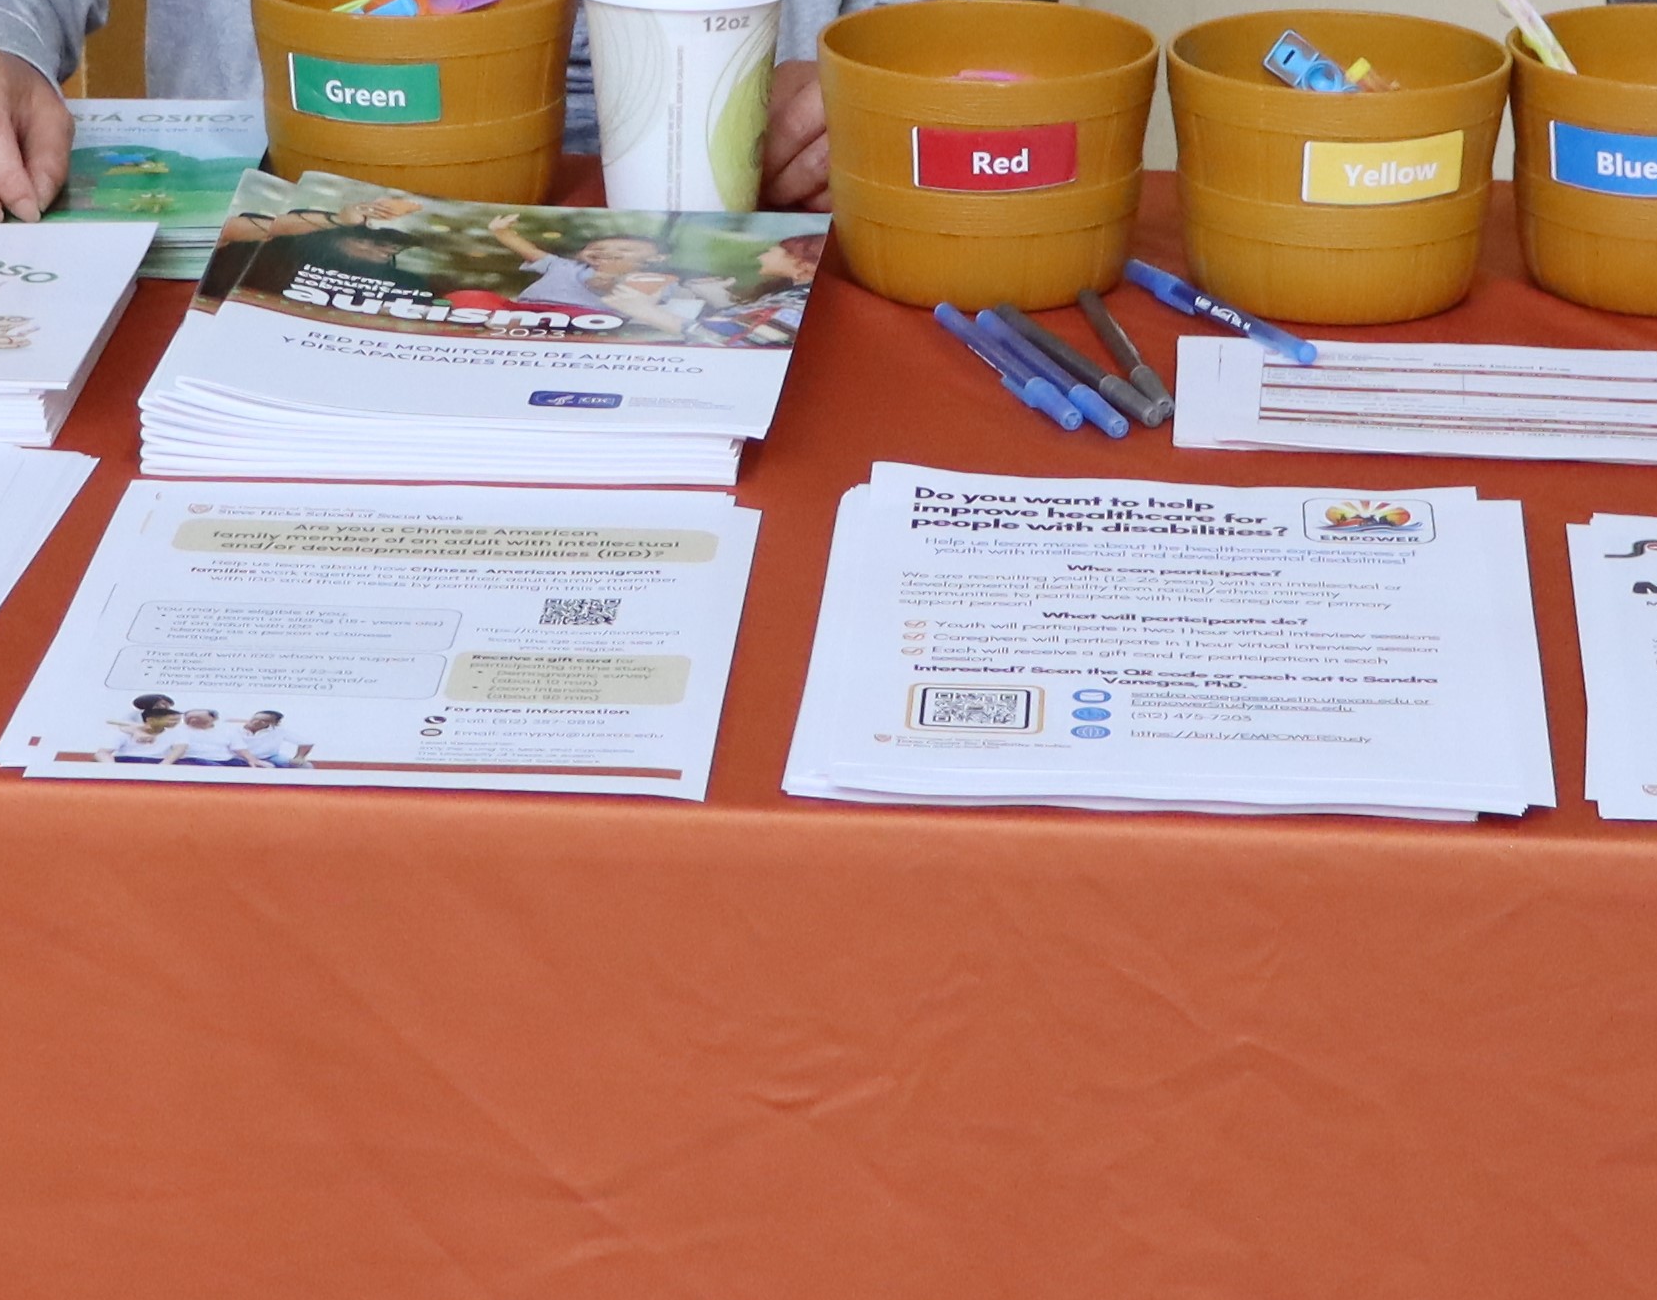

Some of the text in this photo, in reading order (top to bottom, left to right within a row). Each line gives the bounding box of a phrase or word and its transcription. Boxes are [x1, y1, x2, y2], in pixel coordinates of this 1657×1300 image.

[702, 14, 751, 34] 12oz
[325, 79, 406, 109] Green
[972, 150, 1029, 176] Red
[1344, 161, 1439, 187] Yellow
[297, 271, 433, 298] comunitario
[304, 264, 395, 287] Informe
[282, 285, 623, 330] autismo
[491, 328, 567, 338] 2023
[301, 341, 494, 365] DISCAPACIDADES
[552, 362, 703, 374] DESARROLLO
[308, 332, 352, 344] RED
[359, 340, 389, 348] DE
[396, 344, 536, 358] MONITOREO
[579, 354, 685, 363] AUTISMO
[914, 487, 1214, 511] Do you want to help
[913, 503, 1267, 523] improve healthcare for
[336, 526, 375, 534] you
[400, 526, 488, 535] Chinese
[494, 528, 599, 537] American
[911, 518, 1288, 536] people with disabilities?
[213, 532, 280, 541] family
[286, 534, 379, 544] member
[558, 540, 680, 548] intellectual
[221, 541, 664, 558] and/or developmental disabilities (IDD)?
[1067, 564, 1112, 572] Who
[1160, 569, 1282, 577] participate?
[1043, 612, 1097, 620] What
[1141, 614, 1267, 626] participants
[913, 665, 1025, 674] Interested?
[1030, 667, 1082, 675] Scan
[1123, 669, 1154, 677] QR
[1158, 670, 1209, 678] code
[1238, 673, 1297, 681] reach
[1363, 676, 1439, 684] Sandra
[1102, 678, 1248, 689] Vanegas, PhD.
